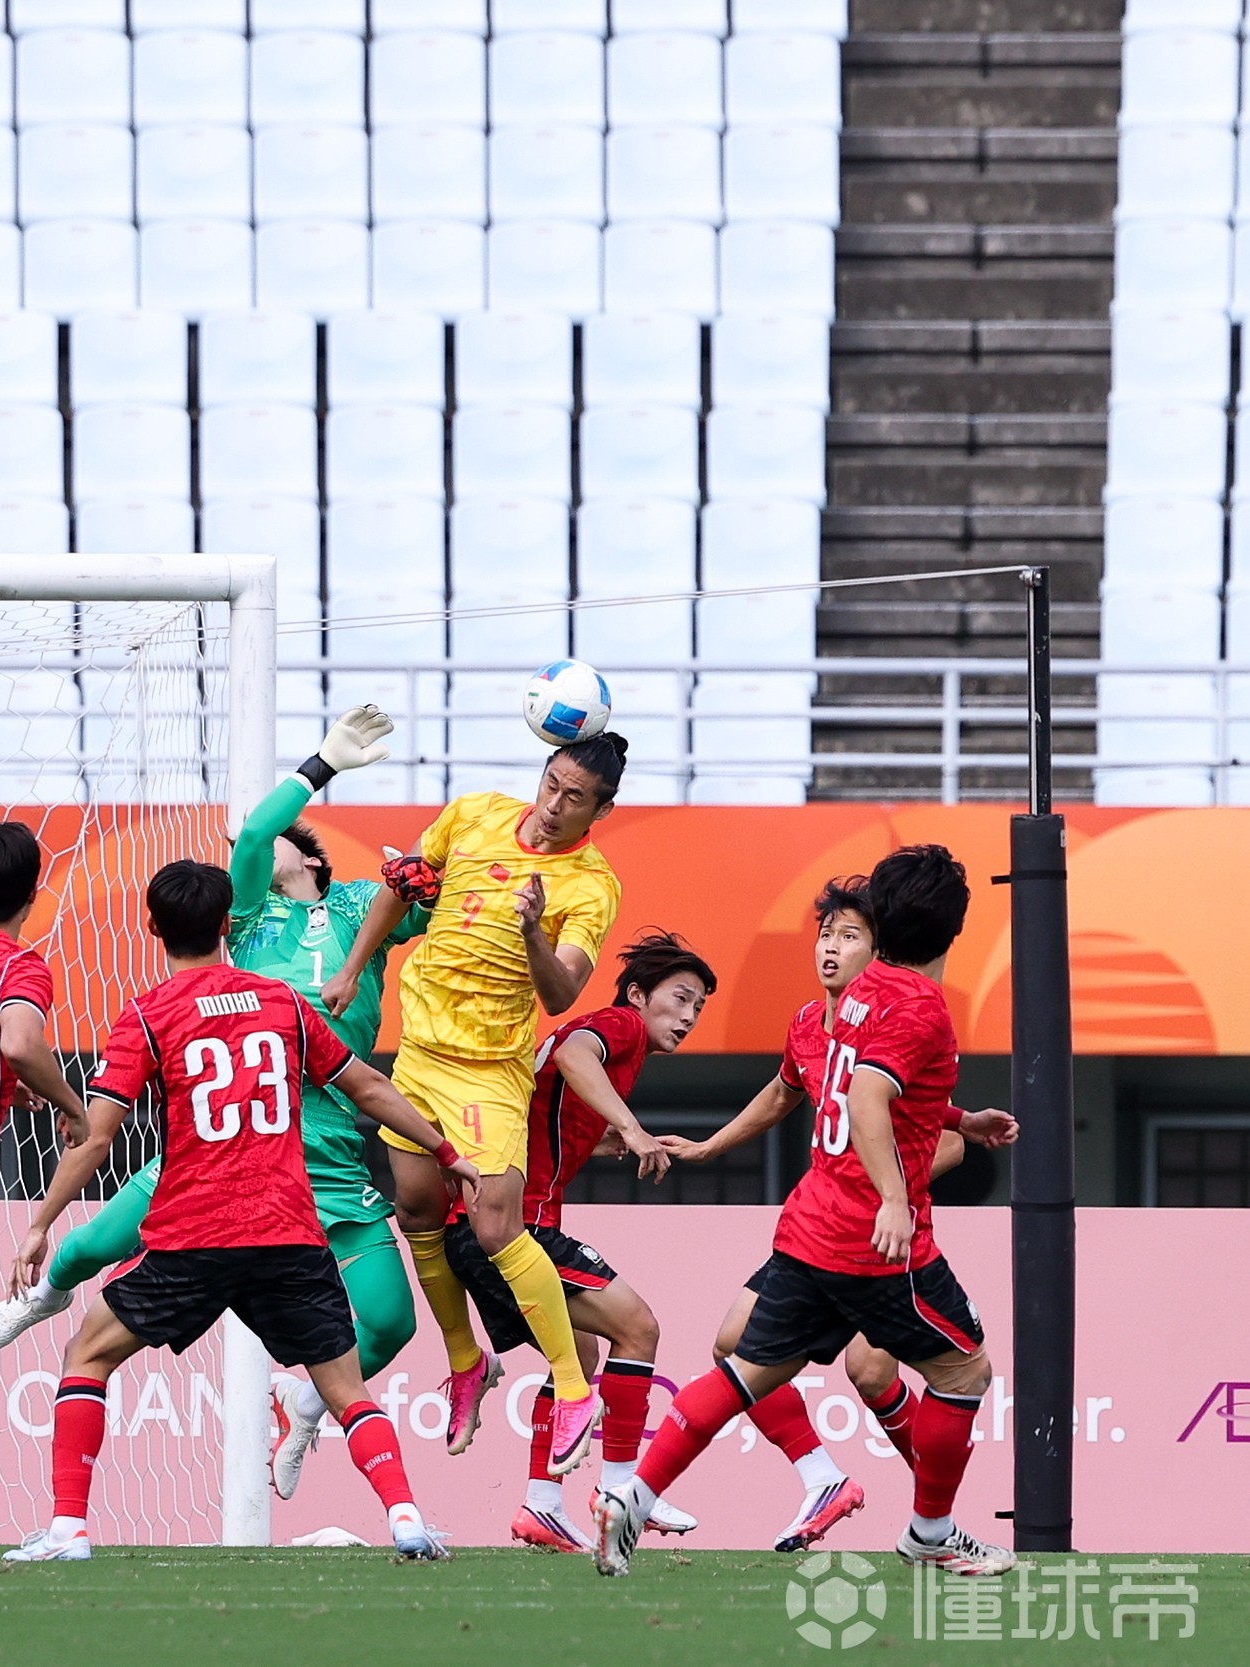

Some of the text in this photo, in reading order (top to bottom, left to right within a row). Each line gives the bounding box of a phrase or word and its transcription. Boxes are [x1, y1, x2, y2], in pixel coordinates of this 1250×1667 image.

[461, 891, 485, 930] 9
[308, 951, 326, 987] 1
[195, 990, 262, 1018] MINHA
[184, 1031, 291, 1142] 23
[462, 1104, 485, 1144] 9
